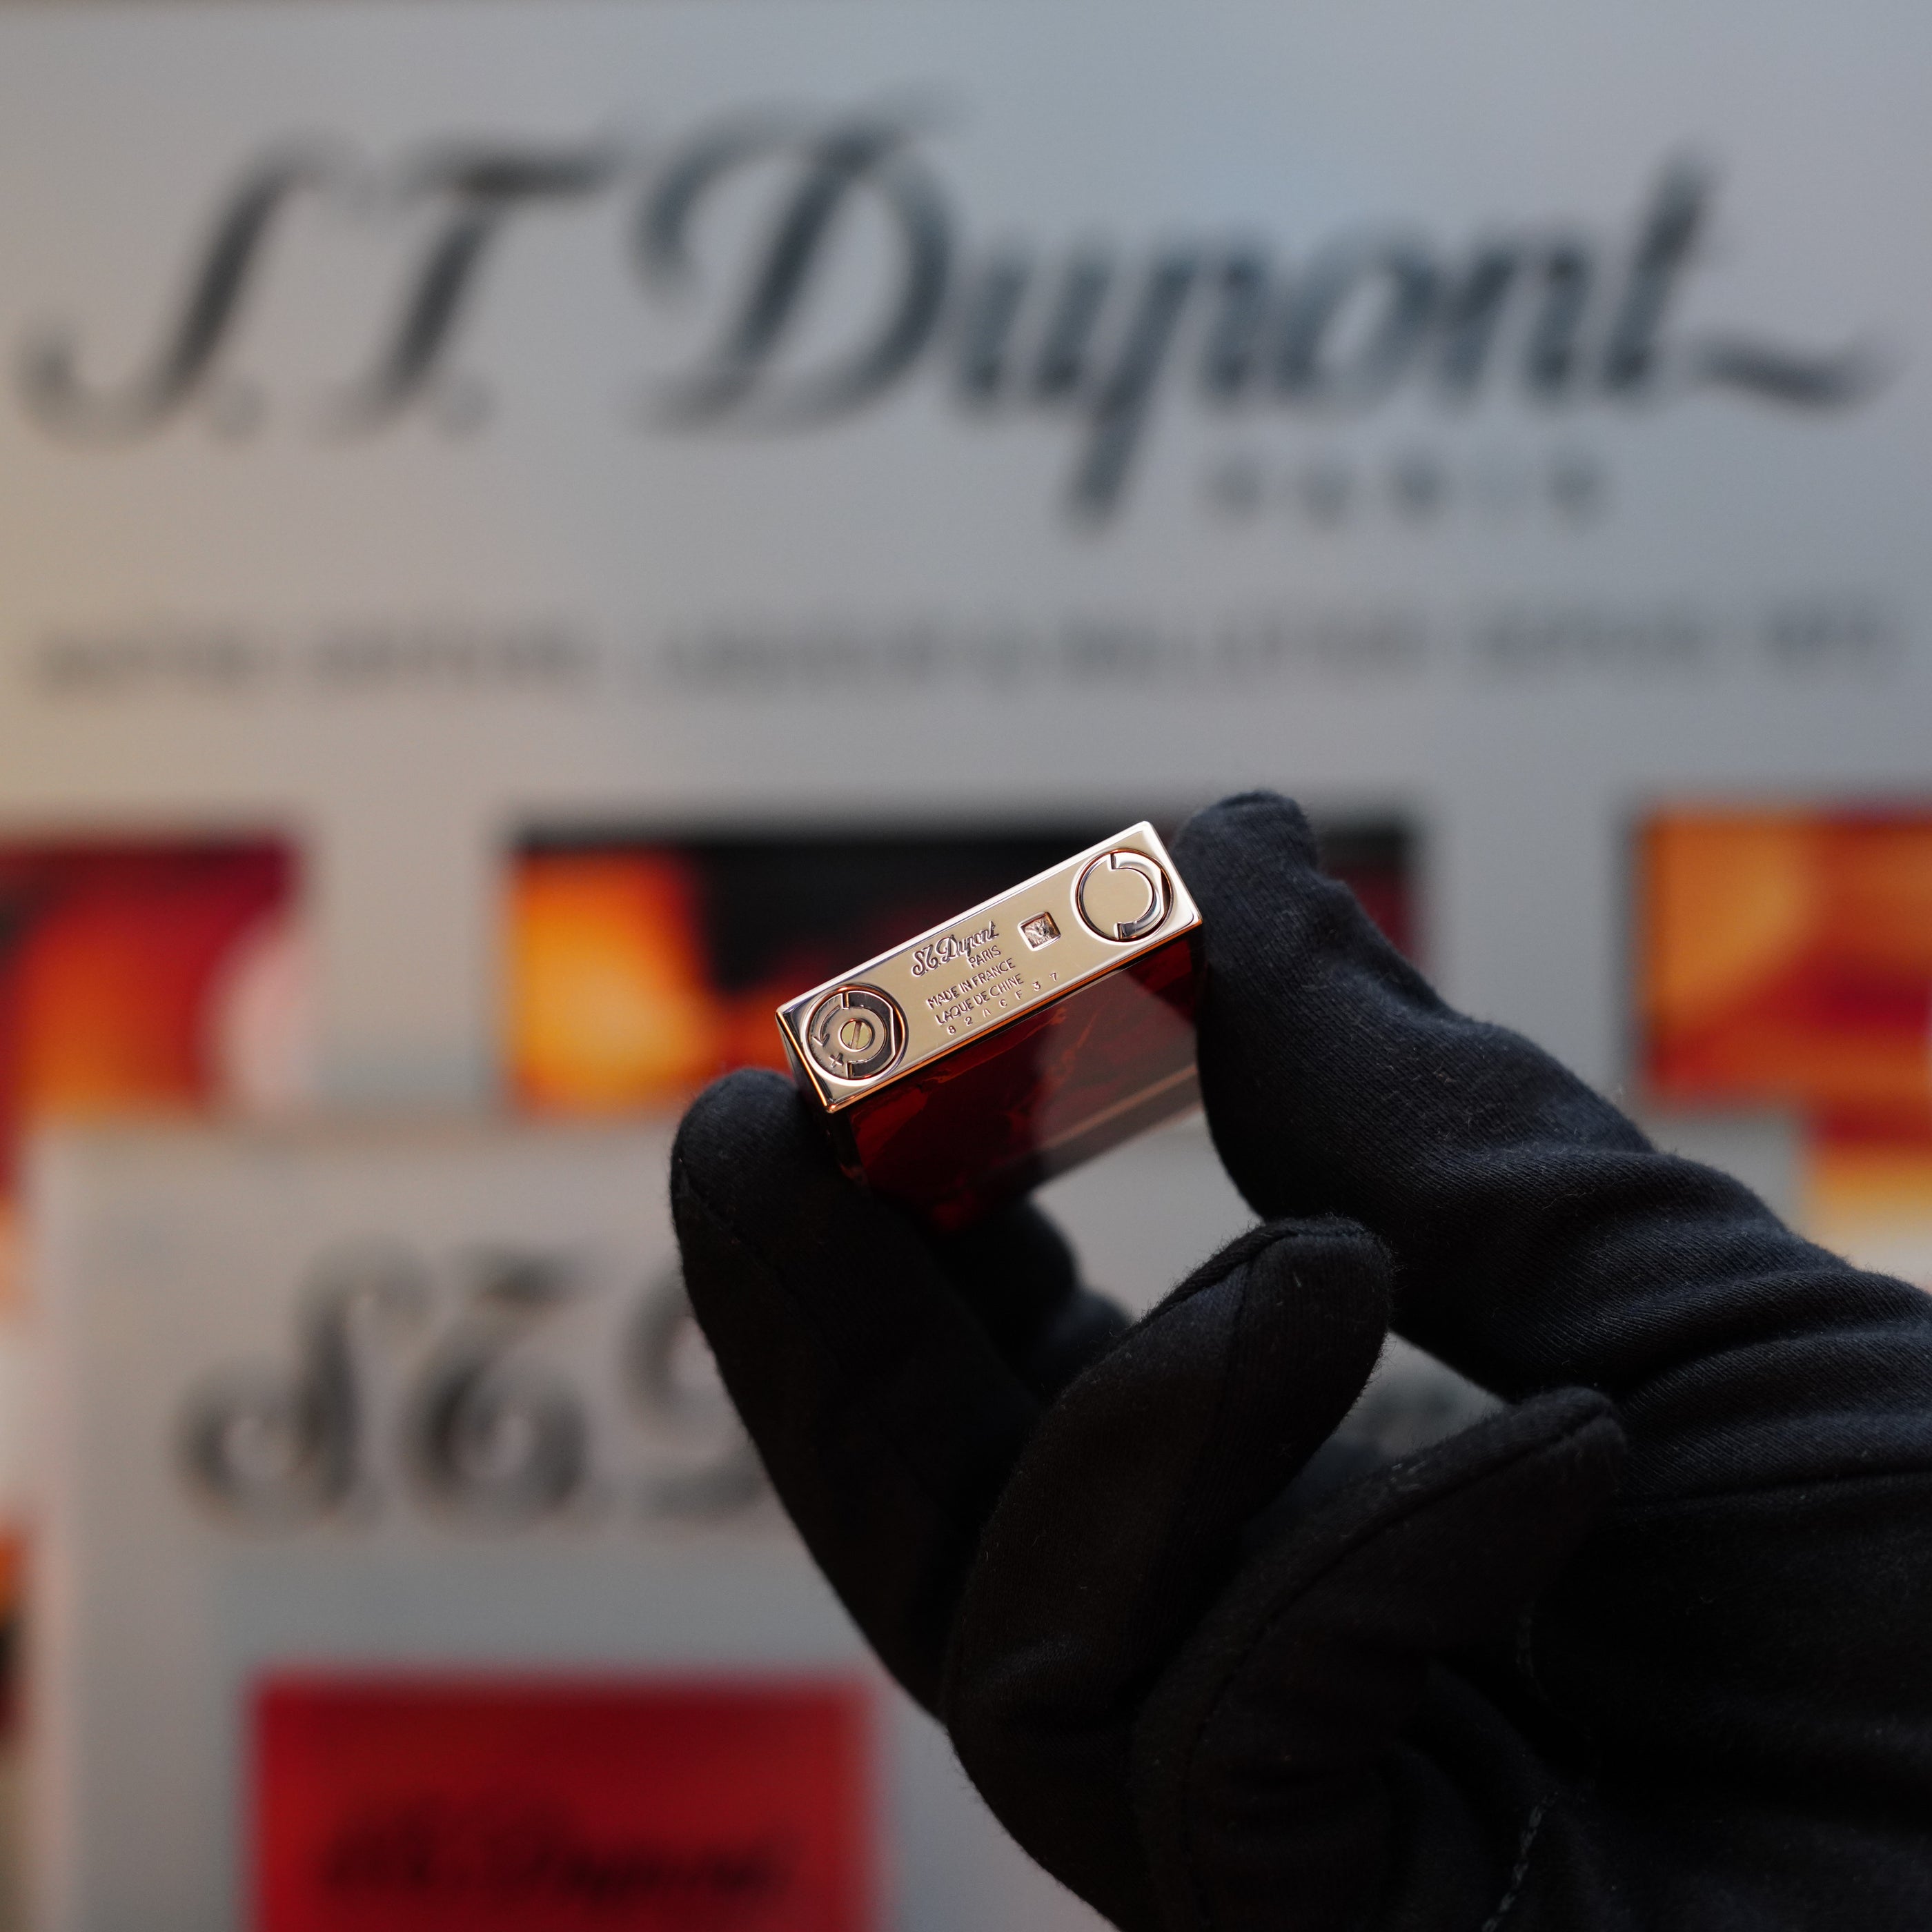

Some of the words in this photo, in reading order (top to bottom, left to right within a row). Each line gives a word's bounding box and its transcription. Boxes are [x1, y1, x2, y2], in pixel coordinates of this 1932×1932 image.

[926, 985, 960, 1009] MADE
[958, 980, 974, 994] IN
[972, 957, 1016, 988] FRANCE
[967, 945, 1001, 969] PARIS
[935, 998, 974, 1026] LAQUE
[973, 990, 991, 1006] DE
[989, 973, 1025, 998] CHINE
